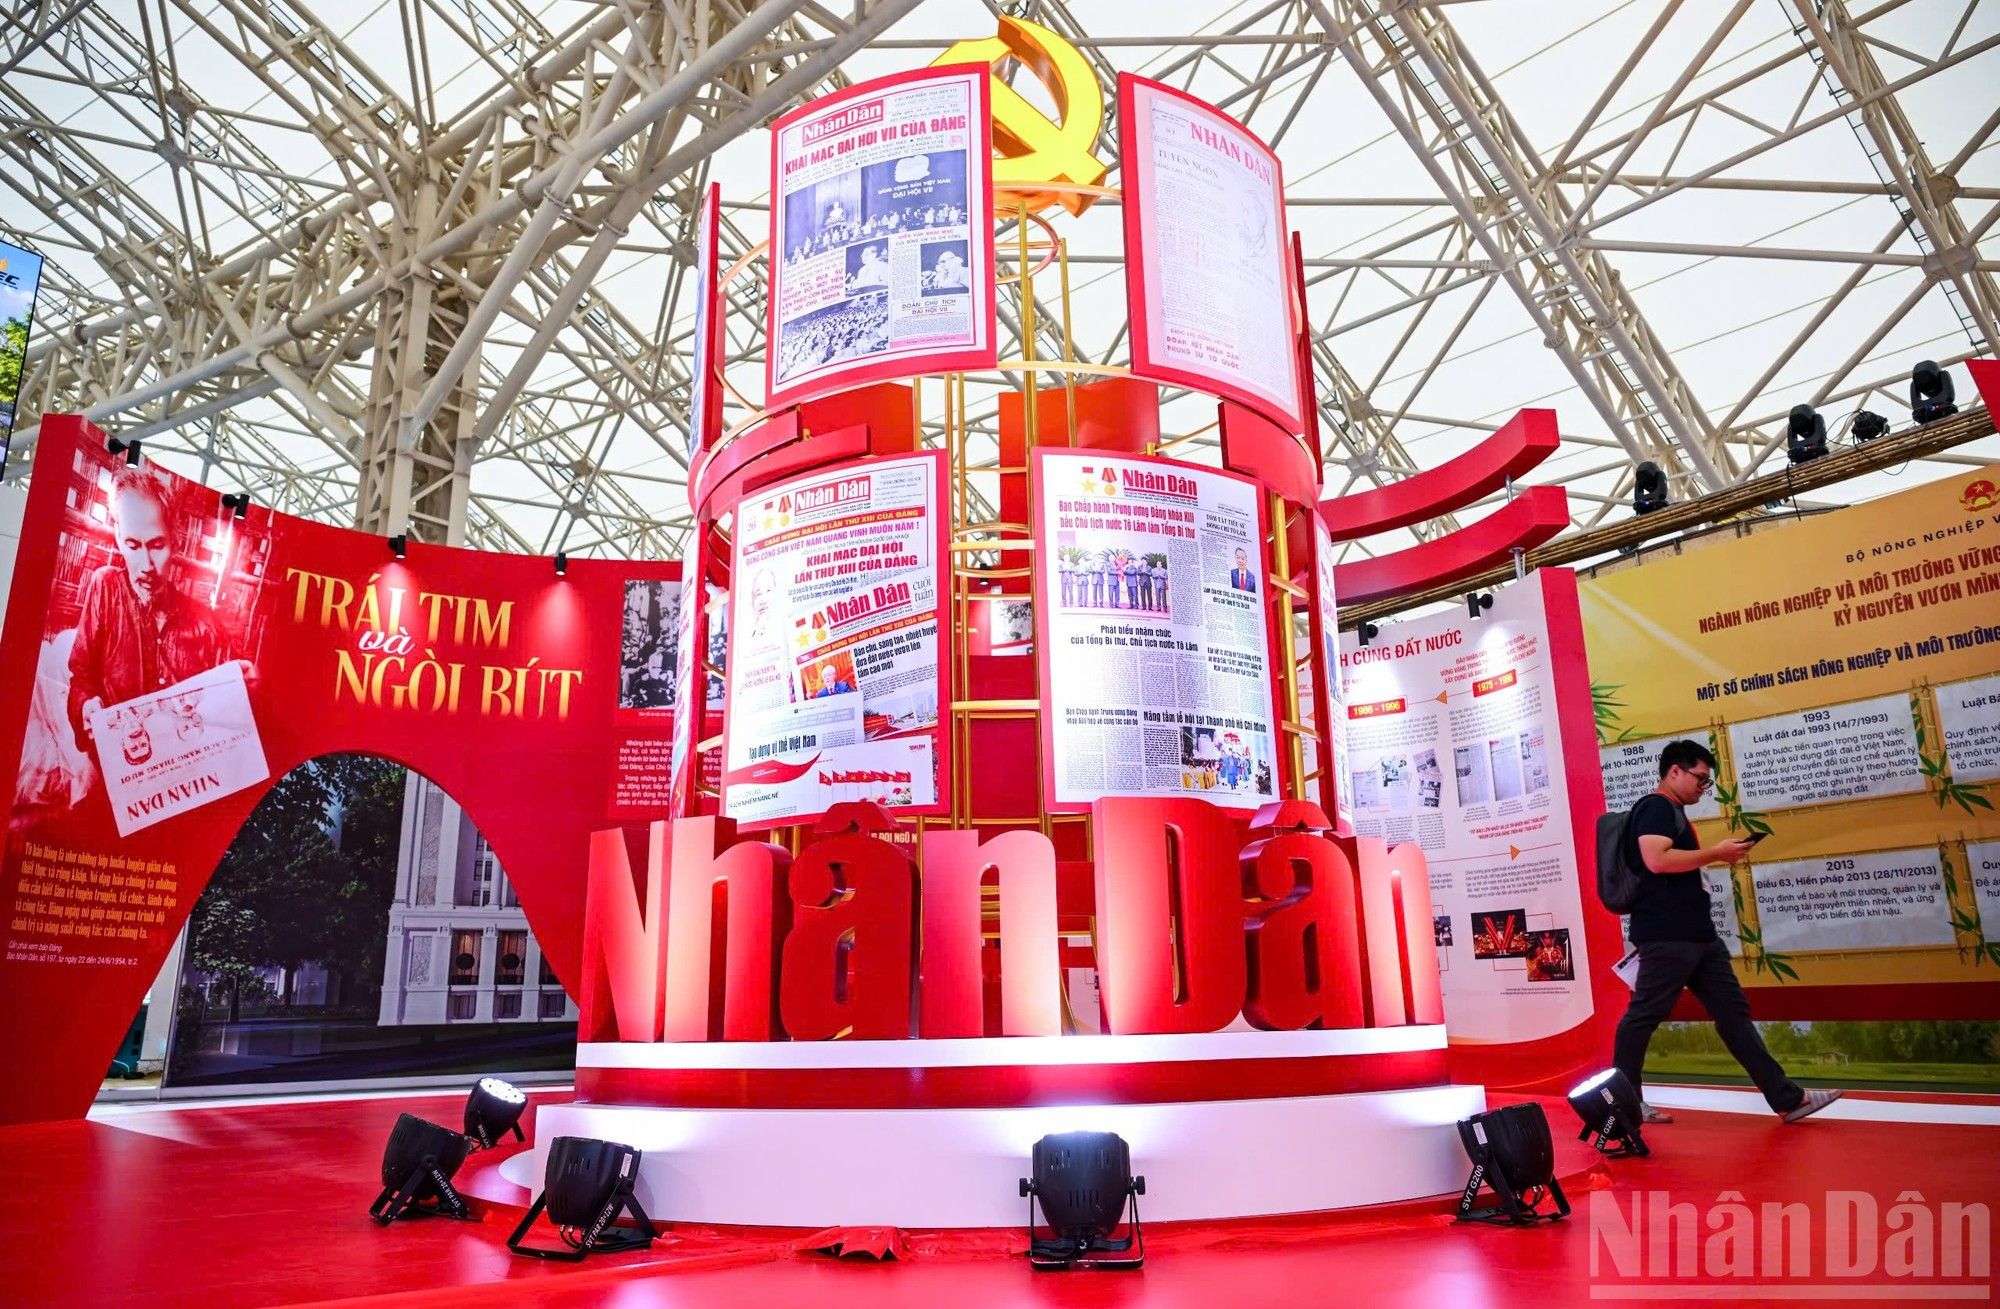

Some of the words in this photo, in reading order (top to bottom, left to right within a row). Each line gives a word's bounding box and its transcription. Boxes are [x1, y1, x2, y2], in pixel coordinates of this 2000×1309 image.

[803, 118, 846, 143] Nhân
[846, 105, 882, 128] Dân
[785, 153, 808, 175] KHAI
[881, 126, 897, 142] VII
[900, 118, 927, 137] CỦA
[931, 115, 966, 133] ĐẢNG
[796, 487, 835, 511] Nhân
[838, 480, 869, 501] Dân
[1122, 469, 1165, 490] Nhân
[1167, 474, 1198, 496] Dân
[806, 553, 831, 567] KHAI
[833, 548, 858, 564] MẠC
[859, 545, 880, 560] ĐẠI
[882, 541, 904, 554] HỘI
[1845, 550, 1865, 563] BỘ
[1872, 537, 1917, 557] NÔNG
[1923, 519, 1985, 543] NGHIỆP
[837, 561, 856, 577] XIII
[858, 557, 883, 572] CỦA
[885, 553, 918, 567] ĐẢNG
[286, 568, 406, 635] TRÁI
[419, 592, 515, 648] TIM
[826, 594, 871, 625] Nhân
[873, 582, 910, 608] Dân
[1699, 609, 1742, 634] NGÀNH
[1744, 601, 1781, 623] NÔNG
[1783, 586, 1832, 614] NGHIỆP
[1836, 579, 1856, 601] VÀ
[1859, 571, 1890, 595] MÔI
[1892, 557, 1954, 589] TRƯỜNG
[1833, 603, 1852, 626] KỶ
[1857, 592, 1914, 622] NGUYÊN
[1917, 581, 1963, 607] VƯƠN
[1966, 573, 2000, 597] MÌN
[358, 626, 415, 655] và
[1352, 646, 1391, 665] CÙNG
[1395, 637, 1422, 658] ĐẤT
[1425, 629, 1462, 652] NƯỚC
[1697, 683, 1721, 701] MỘT
[1723, 675, 1740, 696] SỐ
[1740, 668, 1775, 692] CHÍNH
[1777, 666, 1809, 685] SÁCH
[1811, 658, 1845, 678] NÔNG
[1847, 647, 1892, 671] NGHIỆP
[1895, 640, 1913, 661] VÀ
[1917, 635, 1944, 656] MÔI
[335, 648, 465, 716] NGÒI
[481, 657, 582, 721] BÚT
[1753, 732, 1773, 743] Luật
[1775, 728, 1790, 740] đất
[1792, 725, 1806, 737] đai
[1807, 721, 1831, 733] 1993
[1833, 713, 1889, 731] (14/7/1993)
[1803, 710, 1830, 723] 1993
[1622, 746, 1645, 756] 1988
[1743, 750, 1753, 759] Là
[1755, 748, 1771, 758] một
[1772, 744, 1793, 755] bước
[1795, 740, 1811, 751] tiến
[1812, 739, 1833, 750] quan
[1835, 735, 1859, 746] trọng
[1860, 732, 1884, 744] trong
[1886, 727, 1905, 738] việc
[1613, 755, 1653, 768] 10-NQ/TW
[1615, 773, 1630, 782] nghị
[1631, 769, 1650, 779] quyết
[1756, 879, 1777, 889] Điều
[1779, 879, 1794, 888] 63,
[1796, 876, 1818, 886] Hiến
[1820, 874, 1845, 886] pháp
[1847, 872, 1871, 882] 2013
[1873, 866, 1937, 881] (28/11/2013)
[1826, 860, 1855, 872] 2013
[1758, 895, 1775, 904] Quy
[1776, 893, 1795, 903] định
[1796, 891, 1807, 901] về
[1808, 890, 1826, 900] bảo
[1826, 889, 1839, 900] vệ
[1840, 888, 1856, 898] môi
[1857, 885, 1891, 896] trường,
[1892, 884, 1916, 895] quản
[1917, 883, 1927, 893] lý
[1929, 882, 1941, 891] và
[578, 801, 1065, 1044] Nhân
[1092, 798, 1447, 1035] Dân
[1596, 1134, 1606, 1150] SVT
[1603, 1116, 1616, 1134] G200
[1462, 1191, 1475, 1210] SVT
[1469, 1165, 1484, 1189] G200
